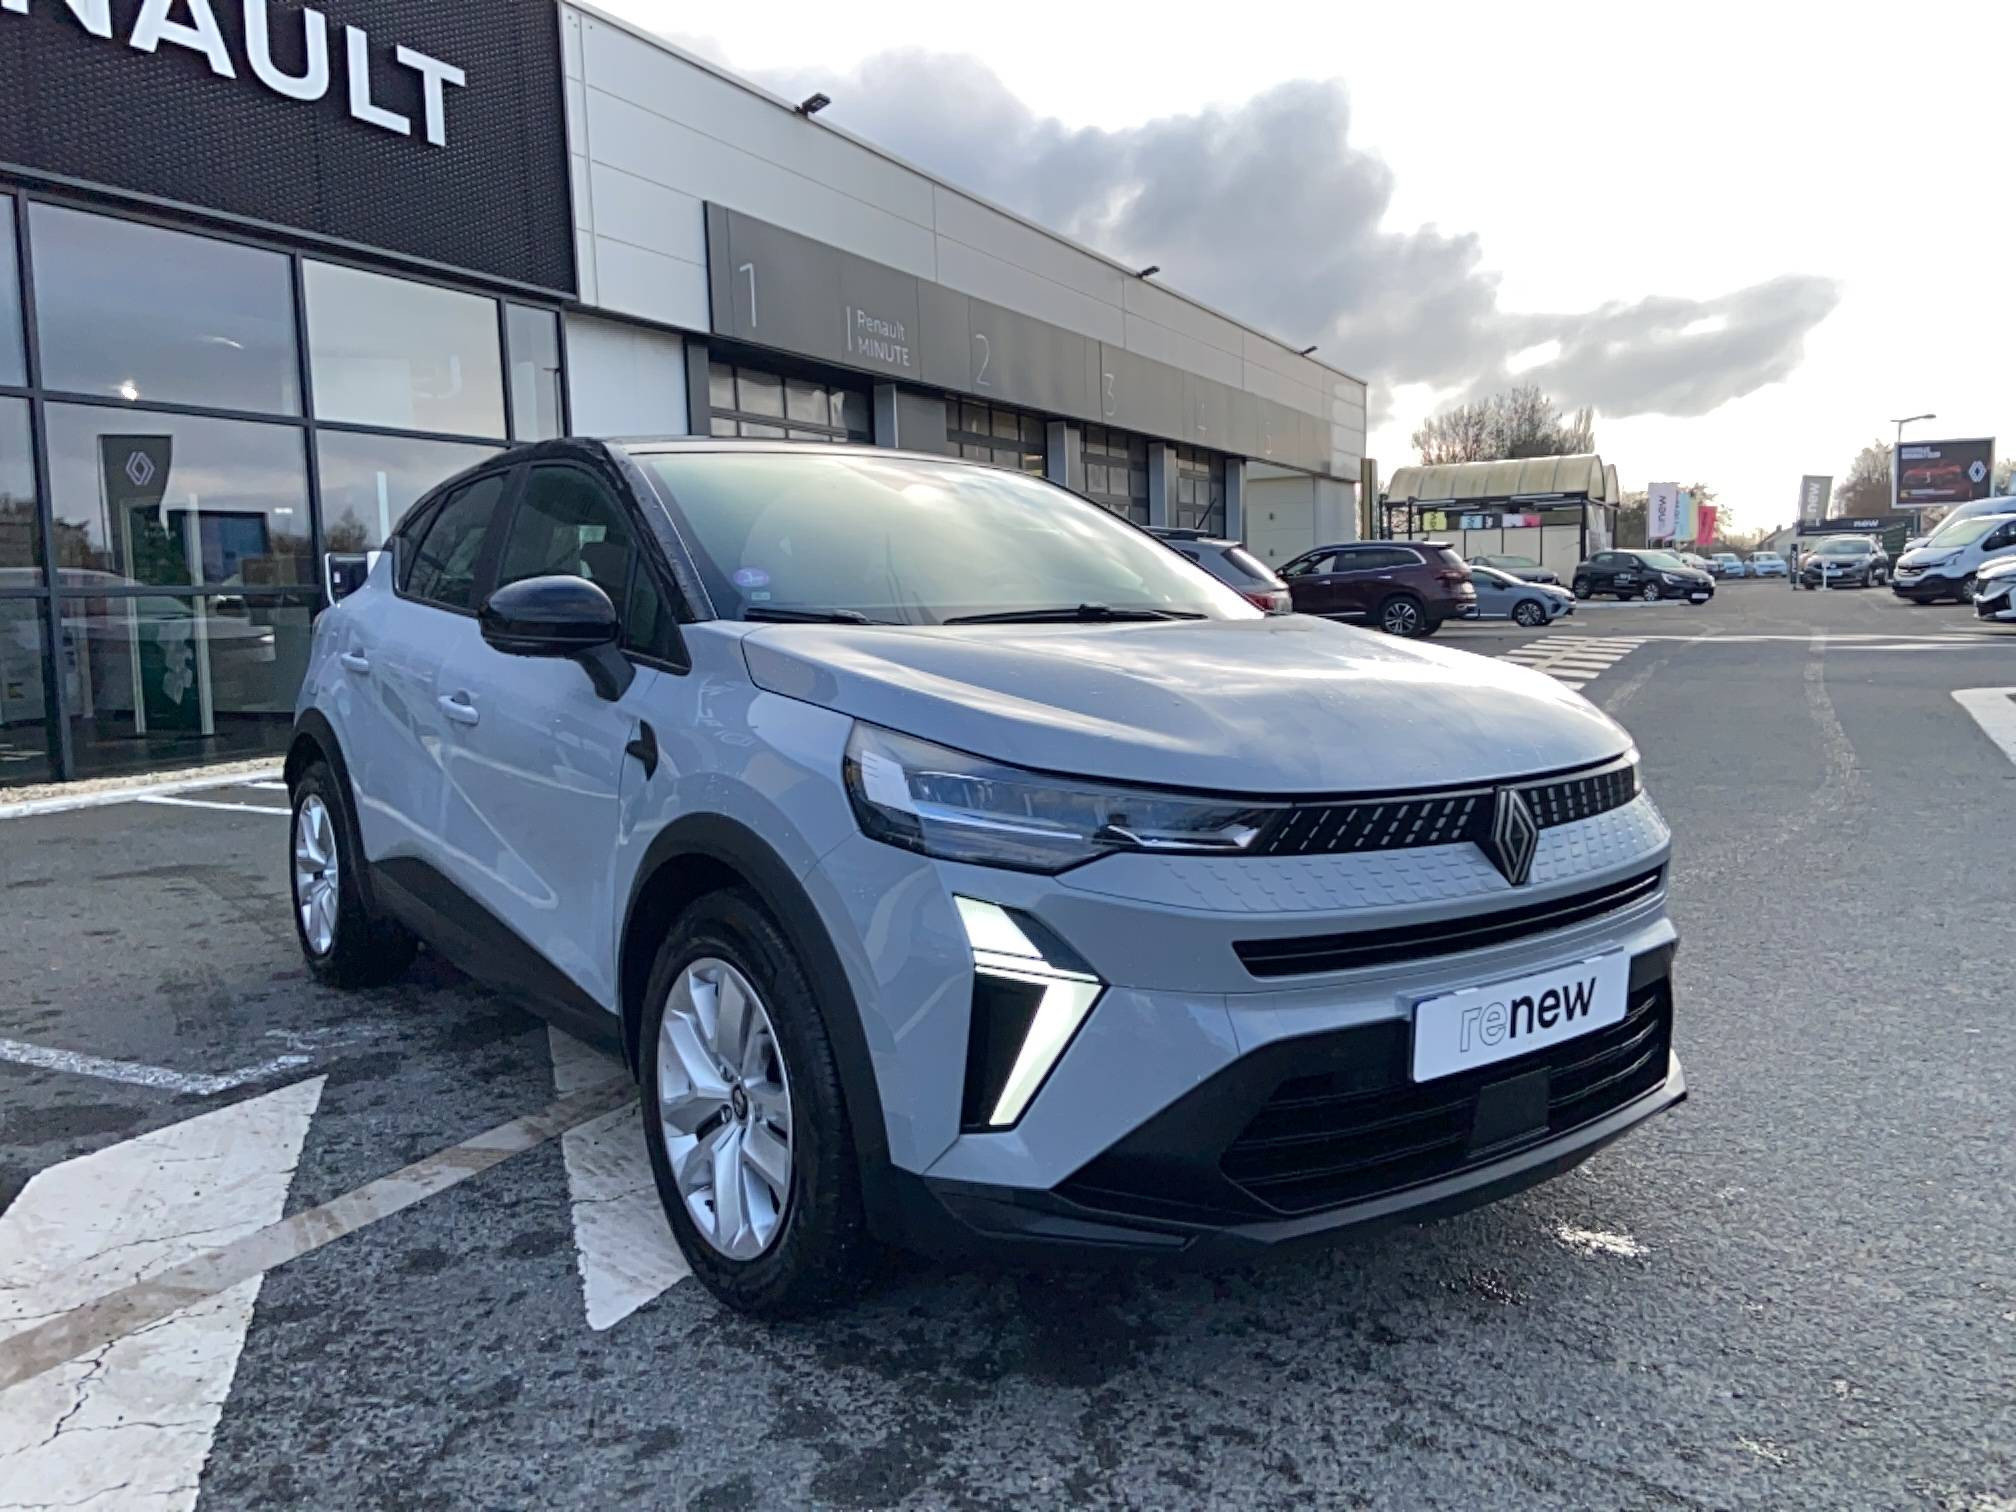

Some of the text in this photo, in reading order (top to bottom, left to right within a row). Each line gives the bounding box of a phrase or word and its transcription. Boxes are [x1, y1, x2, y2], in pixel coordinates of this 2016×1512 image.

[739, 262, 757, 328] 1
[857, 309, 905, 341] Renault
[858, 335, 911, 367] MINUTE
[975, 333, 991, 386] 2
[1104, 372, 1117, 416] 3
[1459, 976, 1597, 1053] renew
